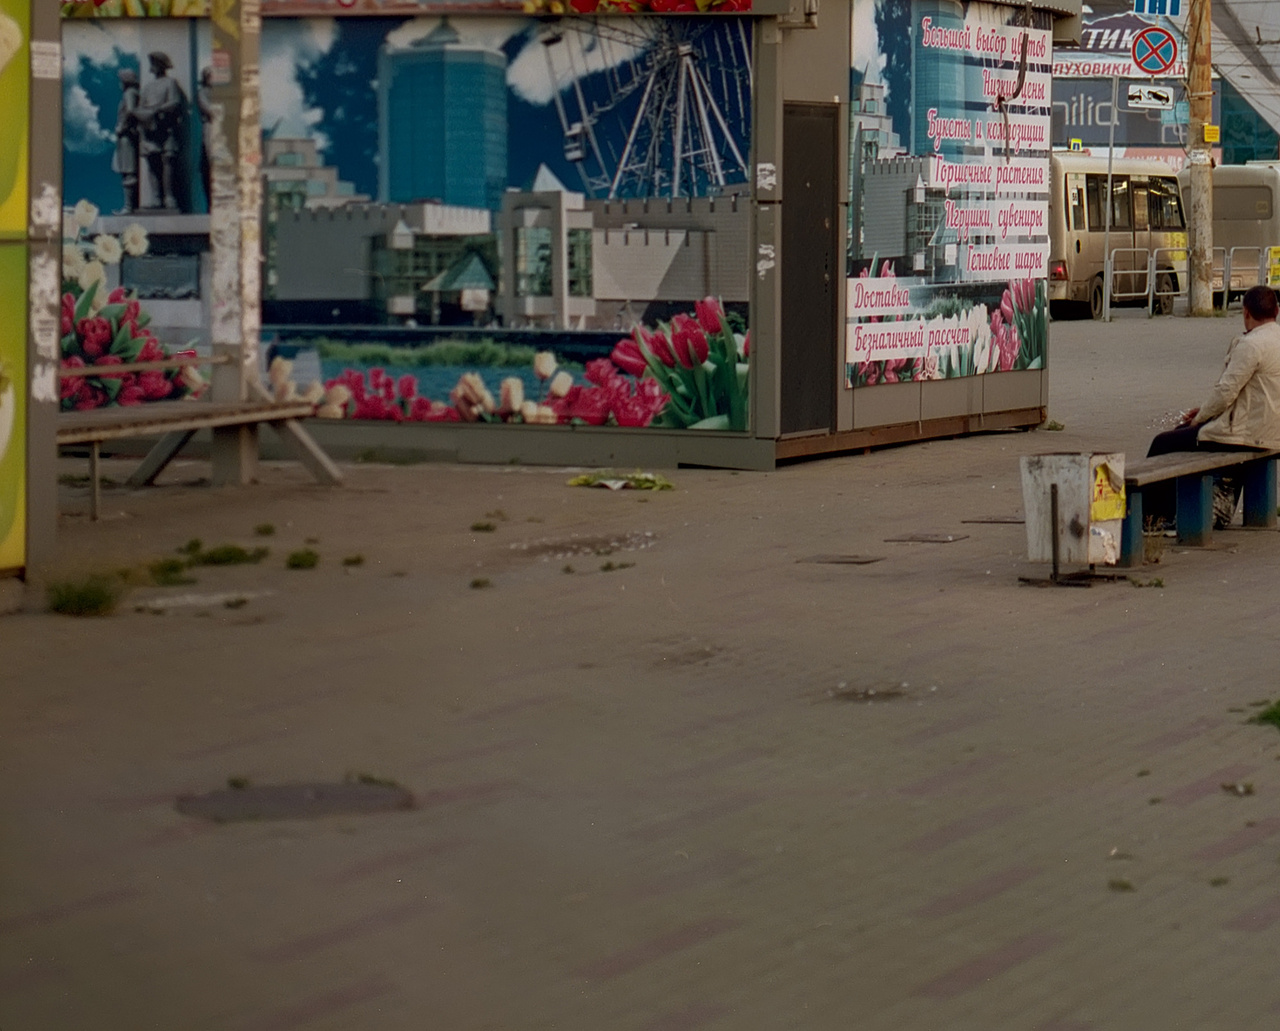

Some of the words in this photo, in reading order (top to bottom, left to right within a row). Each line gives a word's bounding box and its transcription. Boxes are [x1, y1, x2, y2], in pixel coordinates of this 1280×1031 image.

[922, 17, 972, 51] Большой
[976, 26, 1007, 64] выбор
[1011, 31, 1046, 61] цвтов
[1081, 28, 1140, 49] ТИК
[1054, 63, 1132, 75] ПУХОВИКИ
[1021, 81, 1045, 104] цены
[928, 109, 971, 150] Букеты
[975, 121, 982, 139] и
[935, 155, 992, 195] Горшечные
[995, 164, 1044, 194] растения
[945, 200, 993, 239] Игрушки,
[998, 203, 1043, 239] сувениры
[966, 245, 1011, 272] Гелиевые
[1015, 251, 1043, 281] шары
[855, 282, 909, 309] Доставка
[855, 325, 924, 362] Безналичный
[927, 327, 970, 357] рассчет
